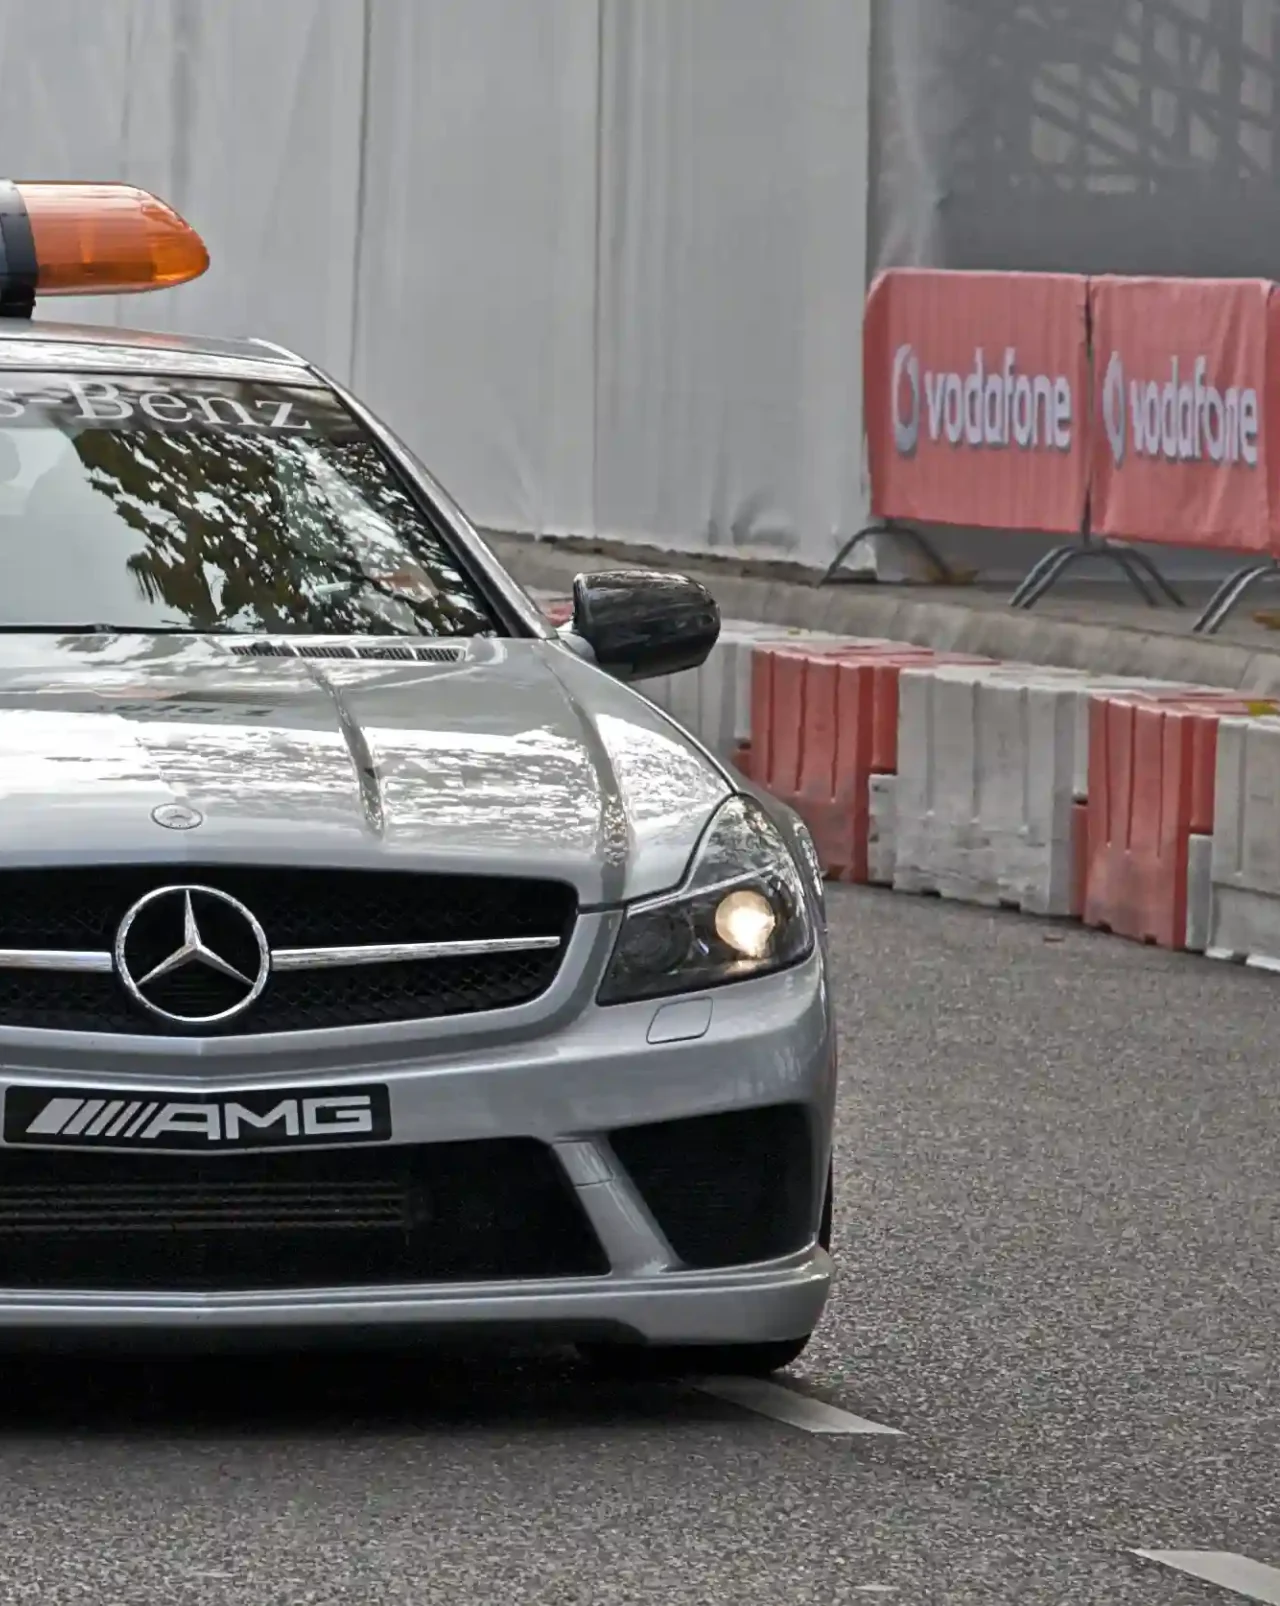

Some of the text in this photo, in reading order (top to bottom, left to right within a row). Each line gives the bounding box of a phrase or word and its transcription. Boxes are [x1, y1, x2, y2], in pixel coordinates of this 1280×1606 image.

[924, 346, 1072, 448] vodafone
[1130, 355, 1258, 463] vodafone
[140, 1095, 373, 1141] AMG
